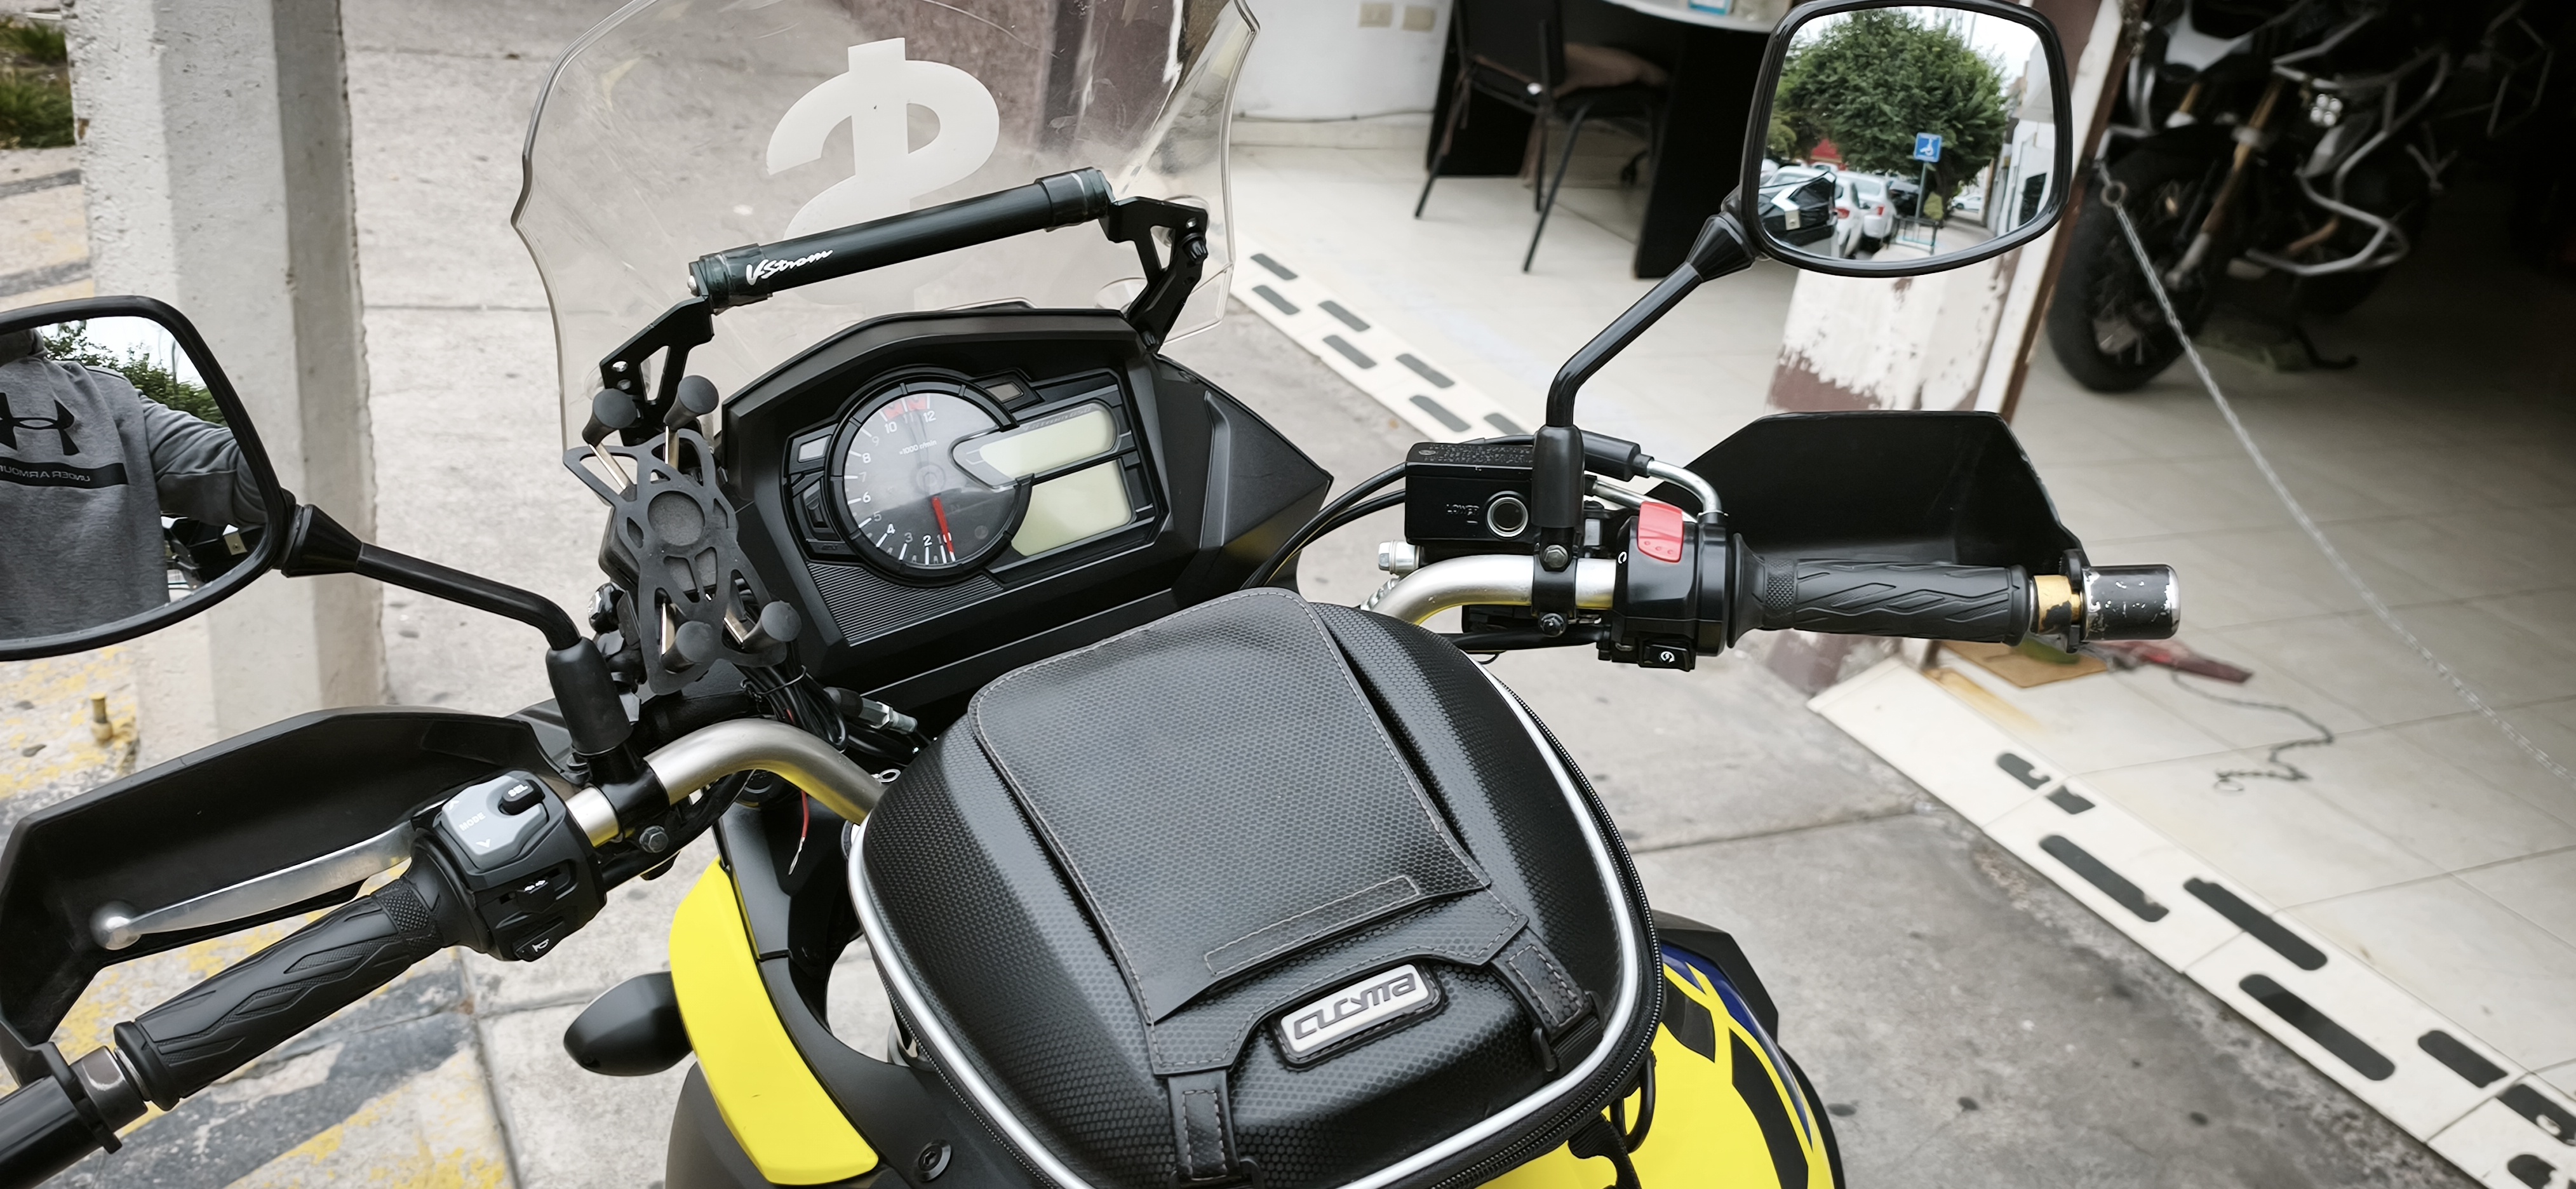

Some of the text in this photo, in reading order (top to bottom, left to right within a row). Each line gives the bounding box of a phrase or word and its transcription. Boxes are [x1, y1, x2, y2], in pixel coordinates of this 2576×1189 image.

[923, 410, 937, 423] 12
[884, 421, 897, 434] 10
[871, 436, 880, 447] 9
[862, 452, 871, 464] 8
[859, 471, 867, 483] 7
[862, 491, 871, 503] 6
[873, 510, 882, 521] 5
[886, 523, 896, 534] 4
[904, 532, 913, 543] 3
[923, 535, 933, 546] 2
[507, 784, 528, 797] SEL
[459, 812, 486, 831] MODE
